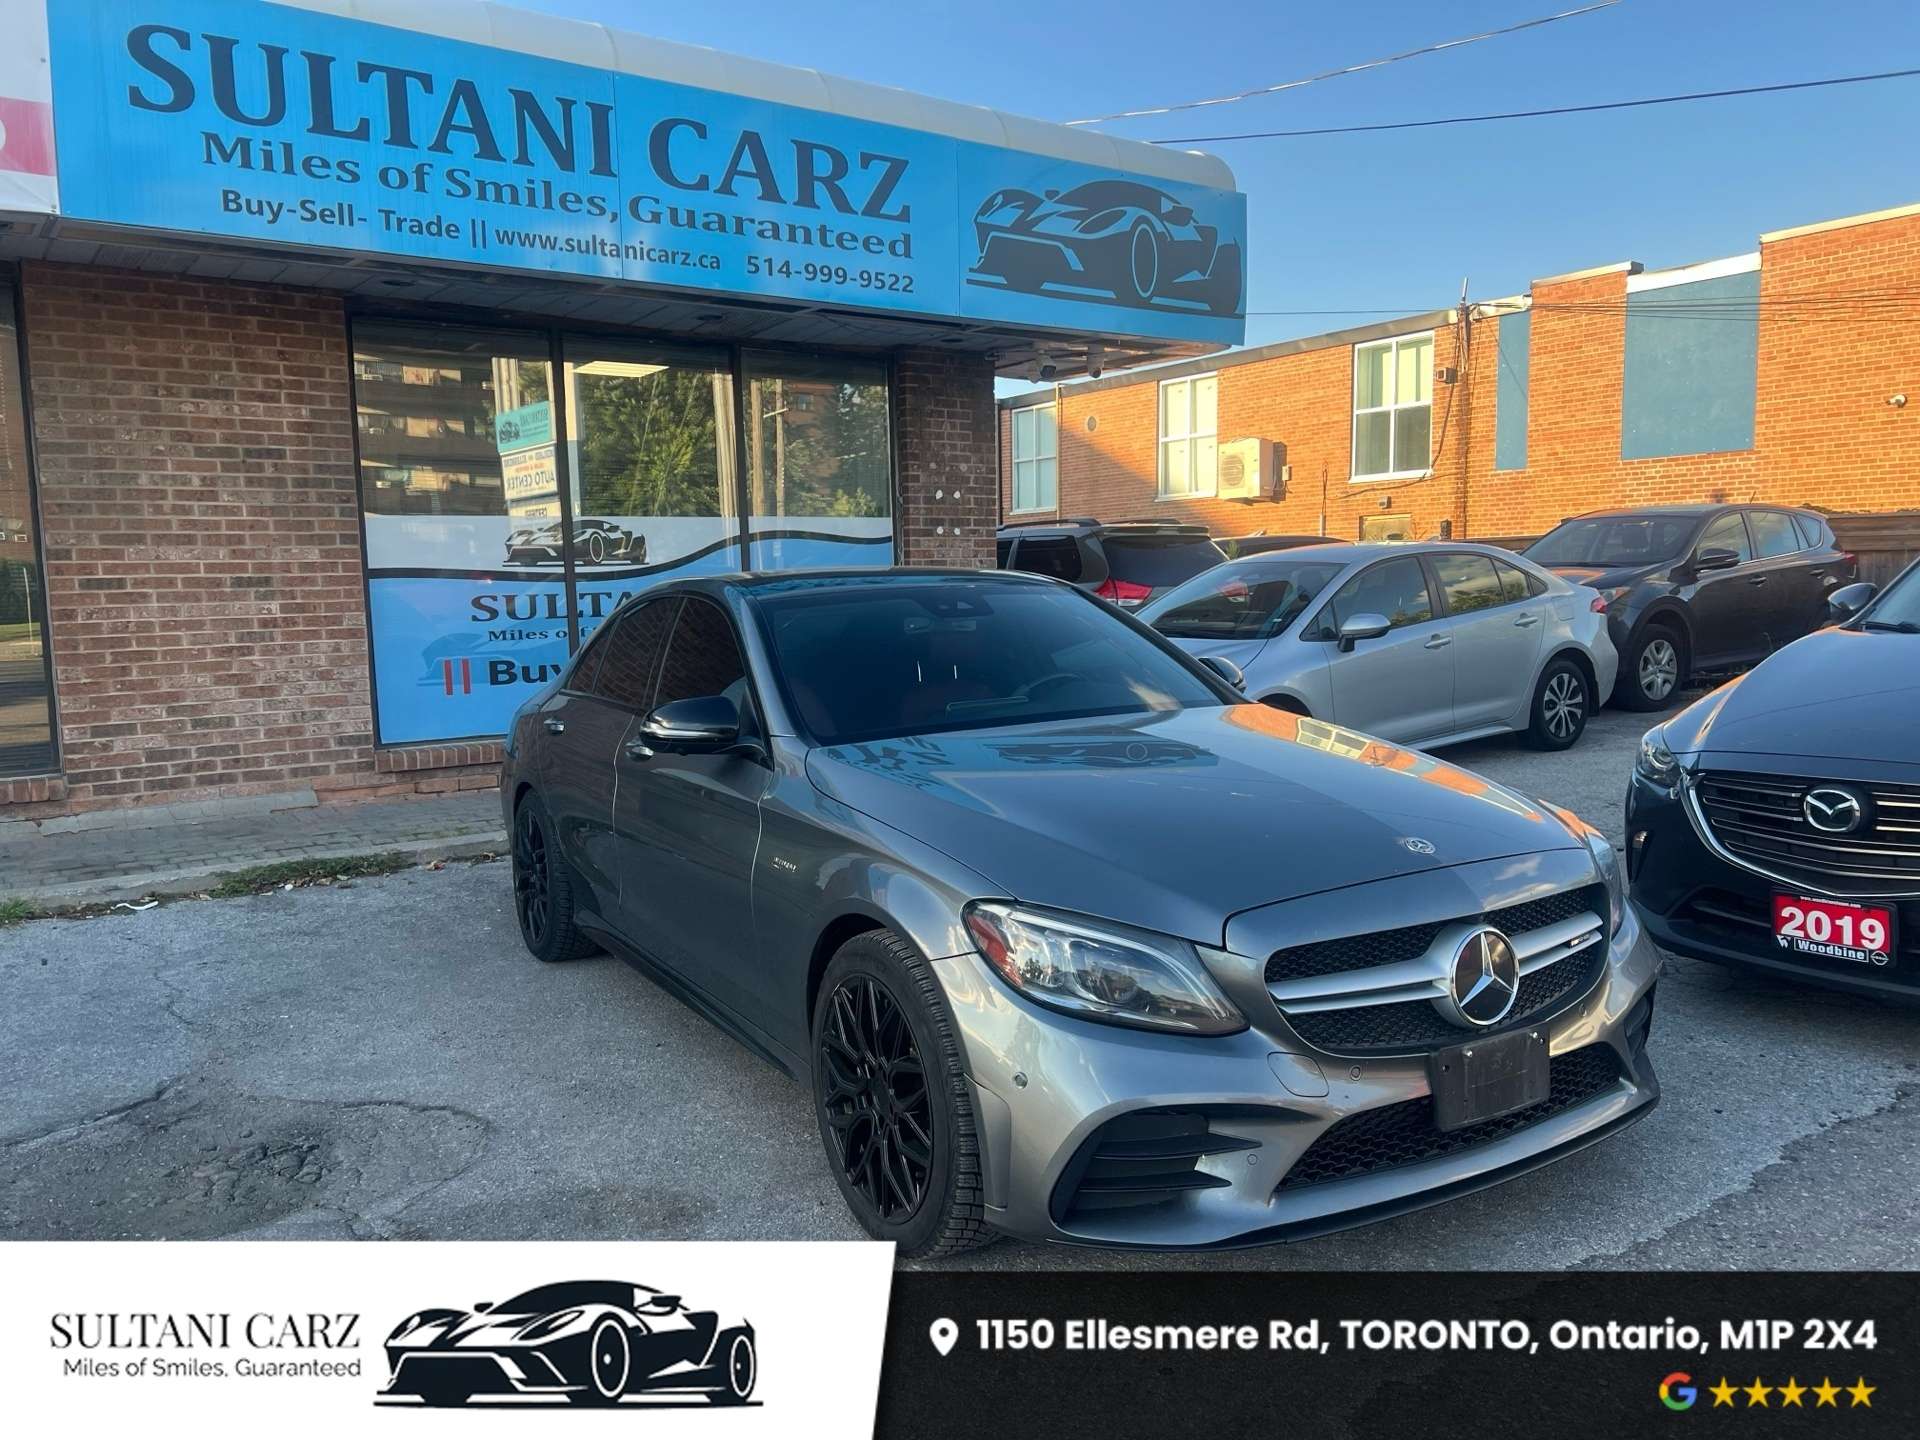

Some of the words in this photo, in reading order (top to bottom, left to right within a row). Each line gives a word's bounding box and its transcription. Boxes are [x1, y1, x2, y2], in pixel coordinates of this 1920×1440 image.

[126, 24, 618, 178] SULTANI
[648, 116, 912, 223] CARZ
[200, 131, 361, 183] Miles
[378, 162, 434, 194] of
[445, 168, 619, 223] Smiles,
[628, 194, 913, 259] Guaranteed
[378, 208, 461, 240] Trade
[495, 227, 722, 270] www.sultanicarz.ca
[746, 254, 916, 295] 514-999-9522
[488, 630, 549, 641] Miles
[1780, 906, 1886, 950] 2019
[1798, 937, 1866, 961] Woodbine
